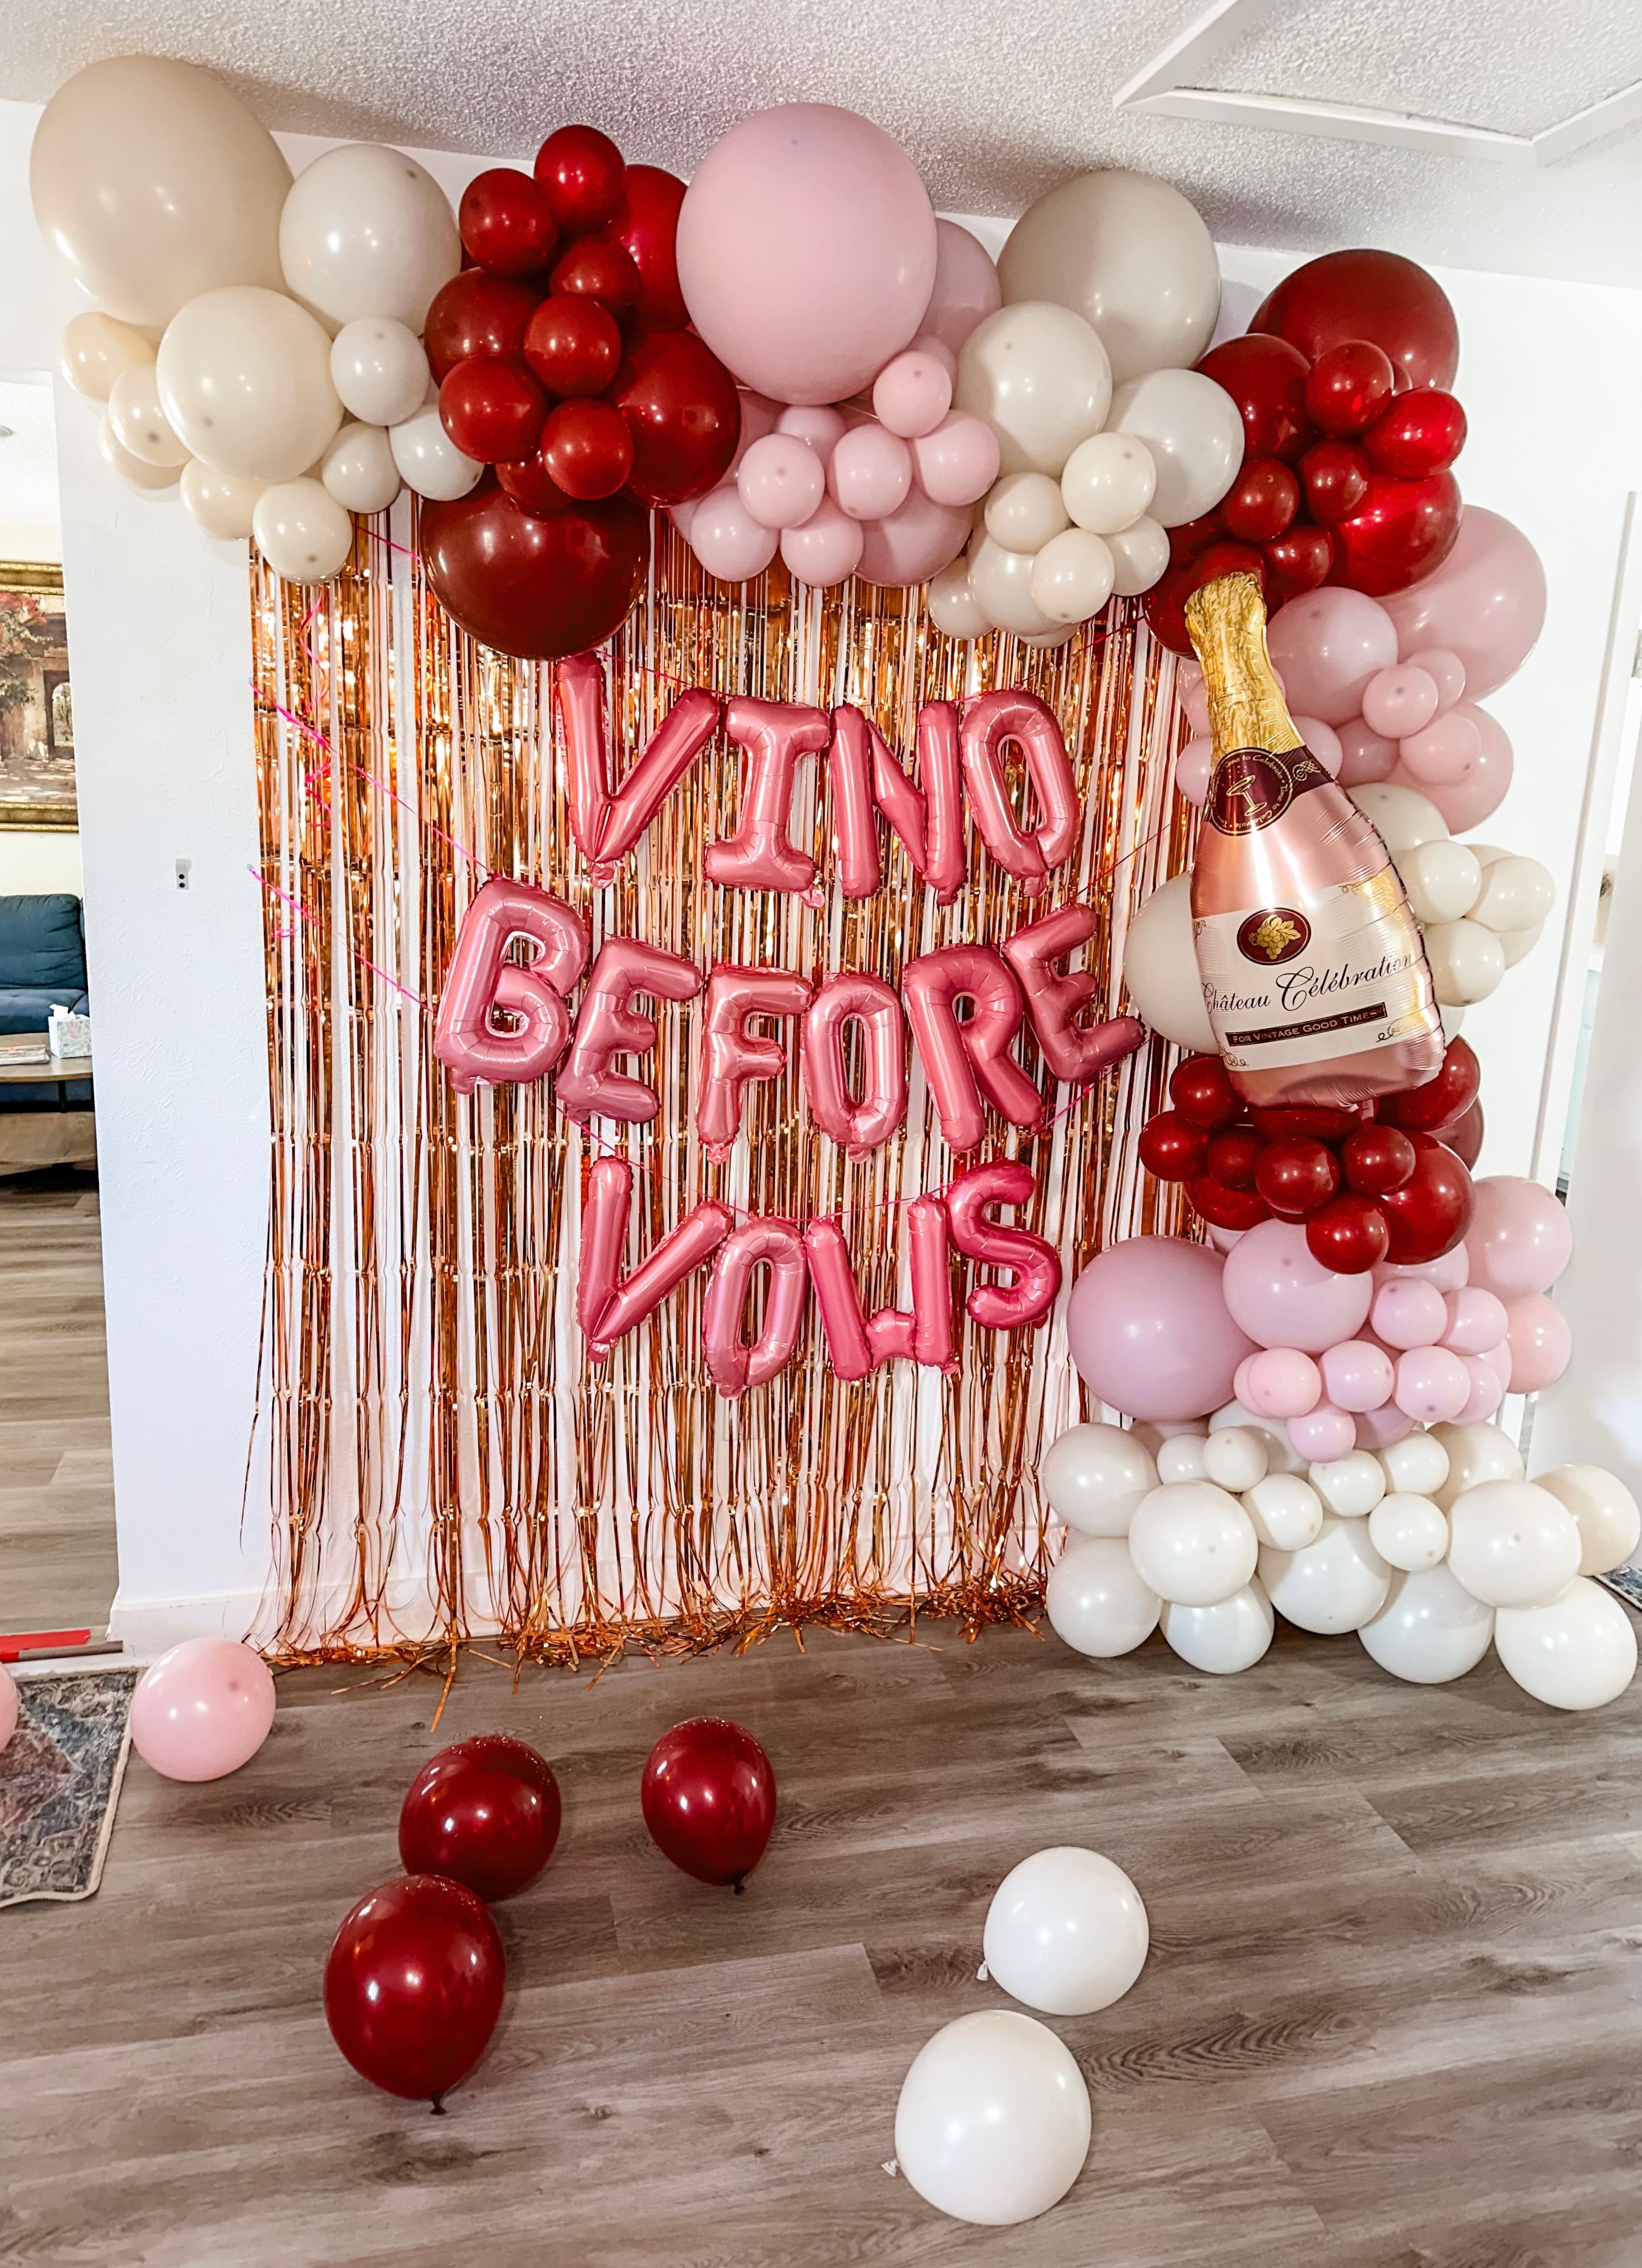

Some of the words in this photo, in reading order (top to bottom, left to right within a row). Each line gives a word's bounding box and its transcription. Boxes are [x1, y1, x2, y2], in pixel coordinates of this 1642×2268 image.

[556, 652, 1081, 905] VINO
[1276, 784, 1288, 802] Time
[433, 879, 1147, 1160] BEFORE
[1201, 982, 1271, 1014] Château
[1276, 953, 1412, 1011] Célébration
[1253, 1028, 1300, 1041] VINTAGE
[1302, 1020, 1338, 1033] GOOD
[1340, 1012, 1378, 1024] TIMES
[577, 1156, 1062, 1398] VOWS
